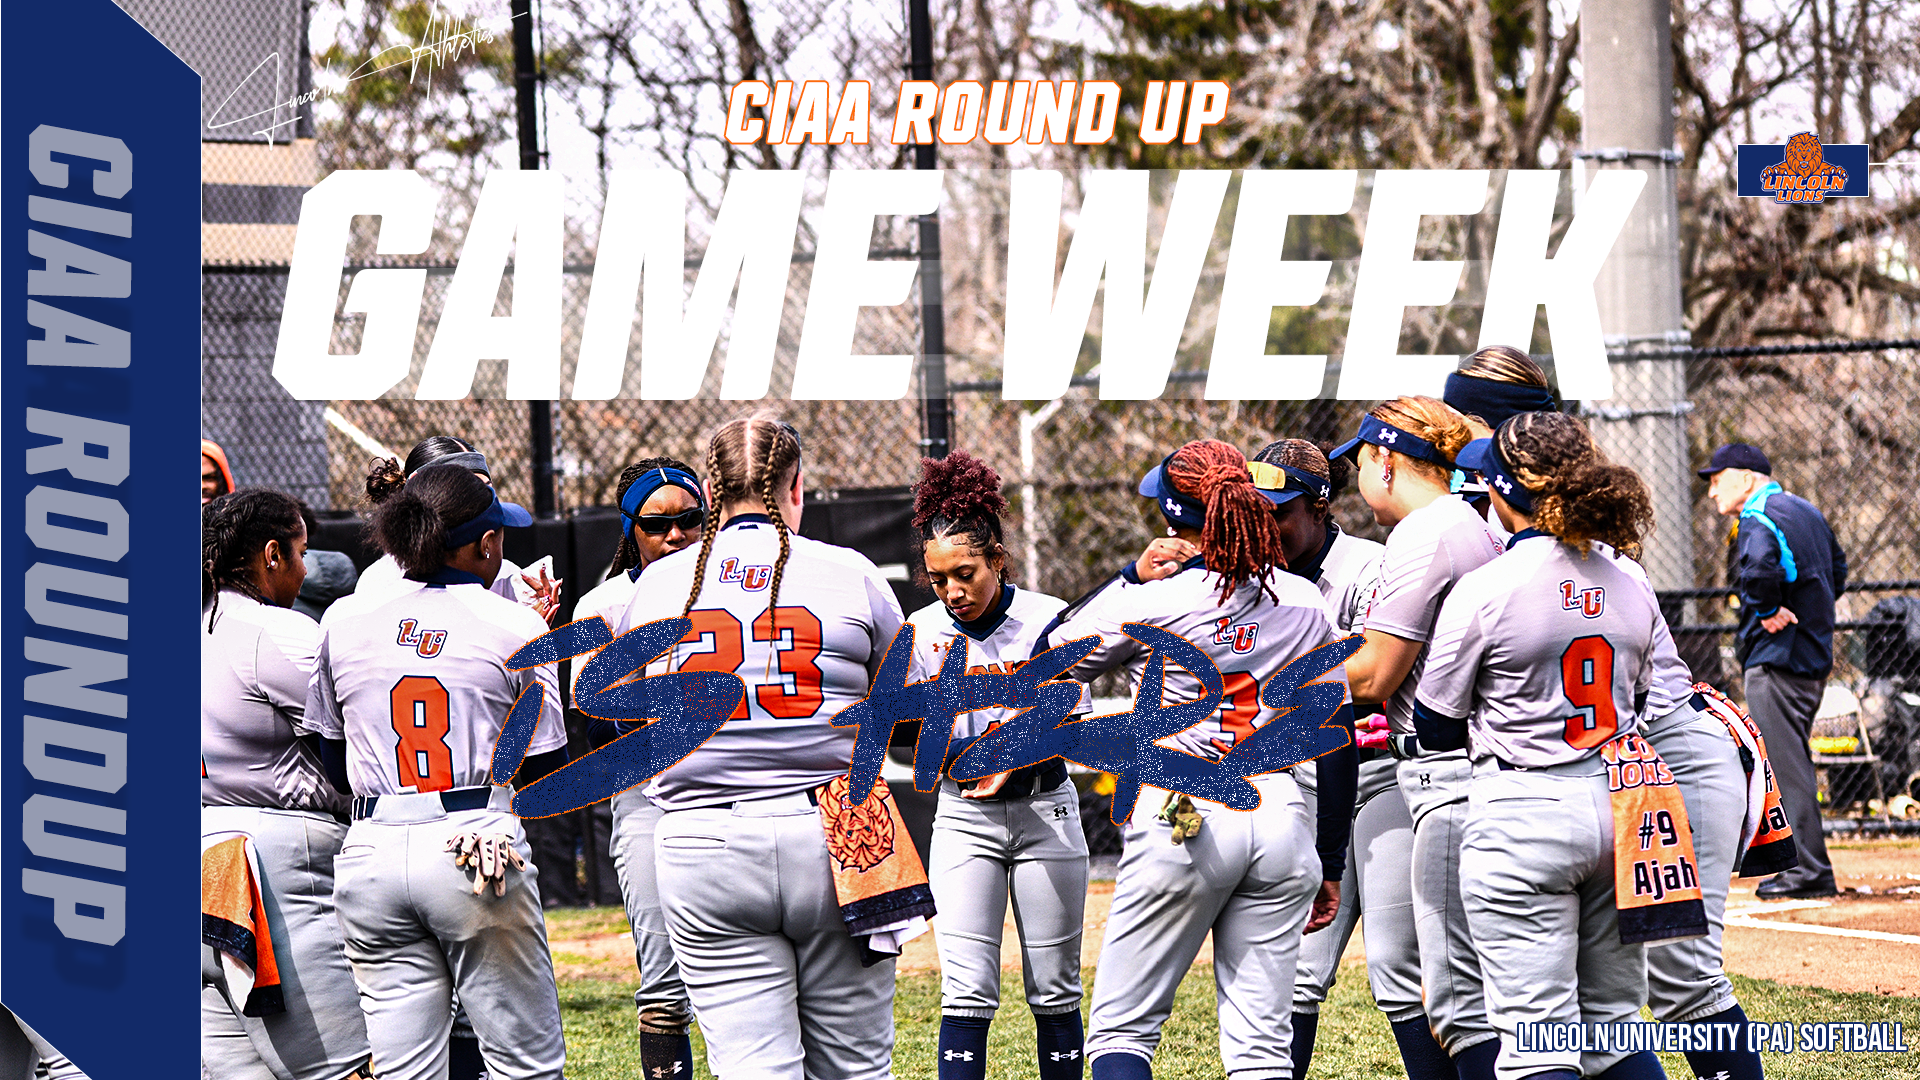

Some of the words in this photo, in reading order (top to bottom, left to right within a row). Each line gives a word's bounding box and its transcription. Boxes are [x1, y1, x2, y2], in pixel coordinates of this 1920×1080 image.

[718, 557, 773, 592] LU
[1559, 580, 1606, 619] LU
[397, 618, 448, 659] LU
[1213, 616, 1260, 655] LU
[678, 606, 825, 721] 23
[1560, 634, 1620, 751] 9
[390, 675, 455, 793] 8
[1638, 809, 1680, 851] #9
[1633, 856, 1699, 902] Ajah
